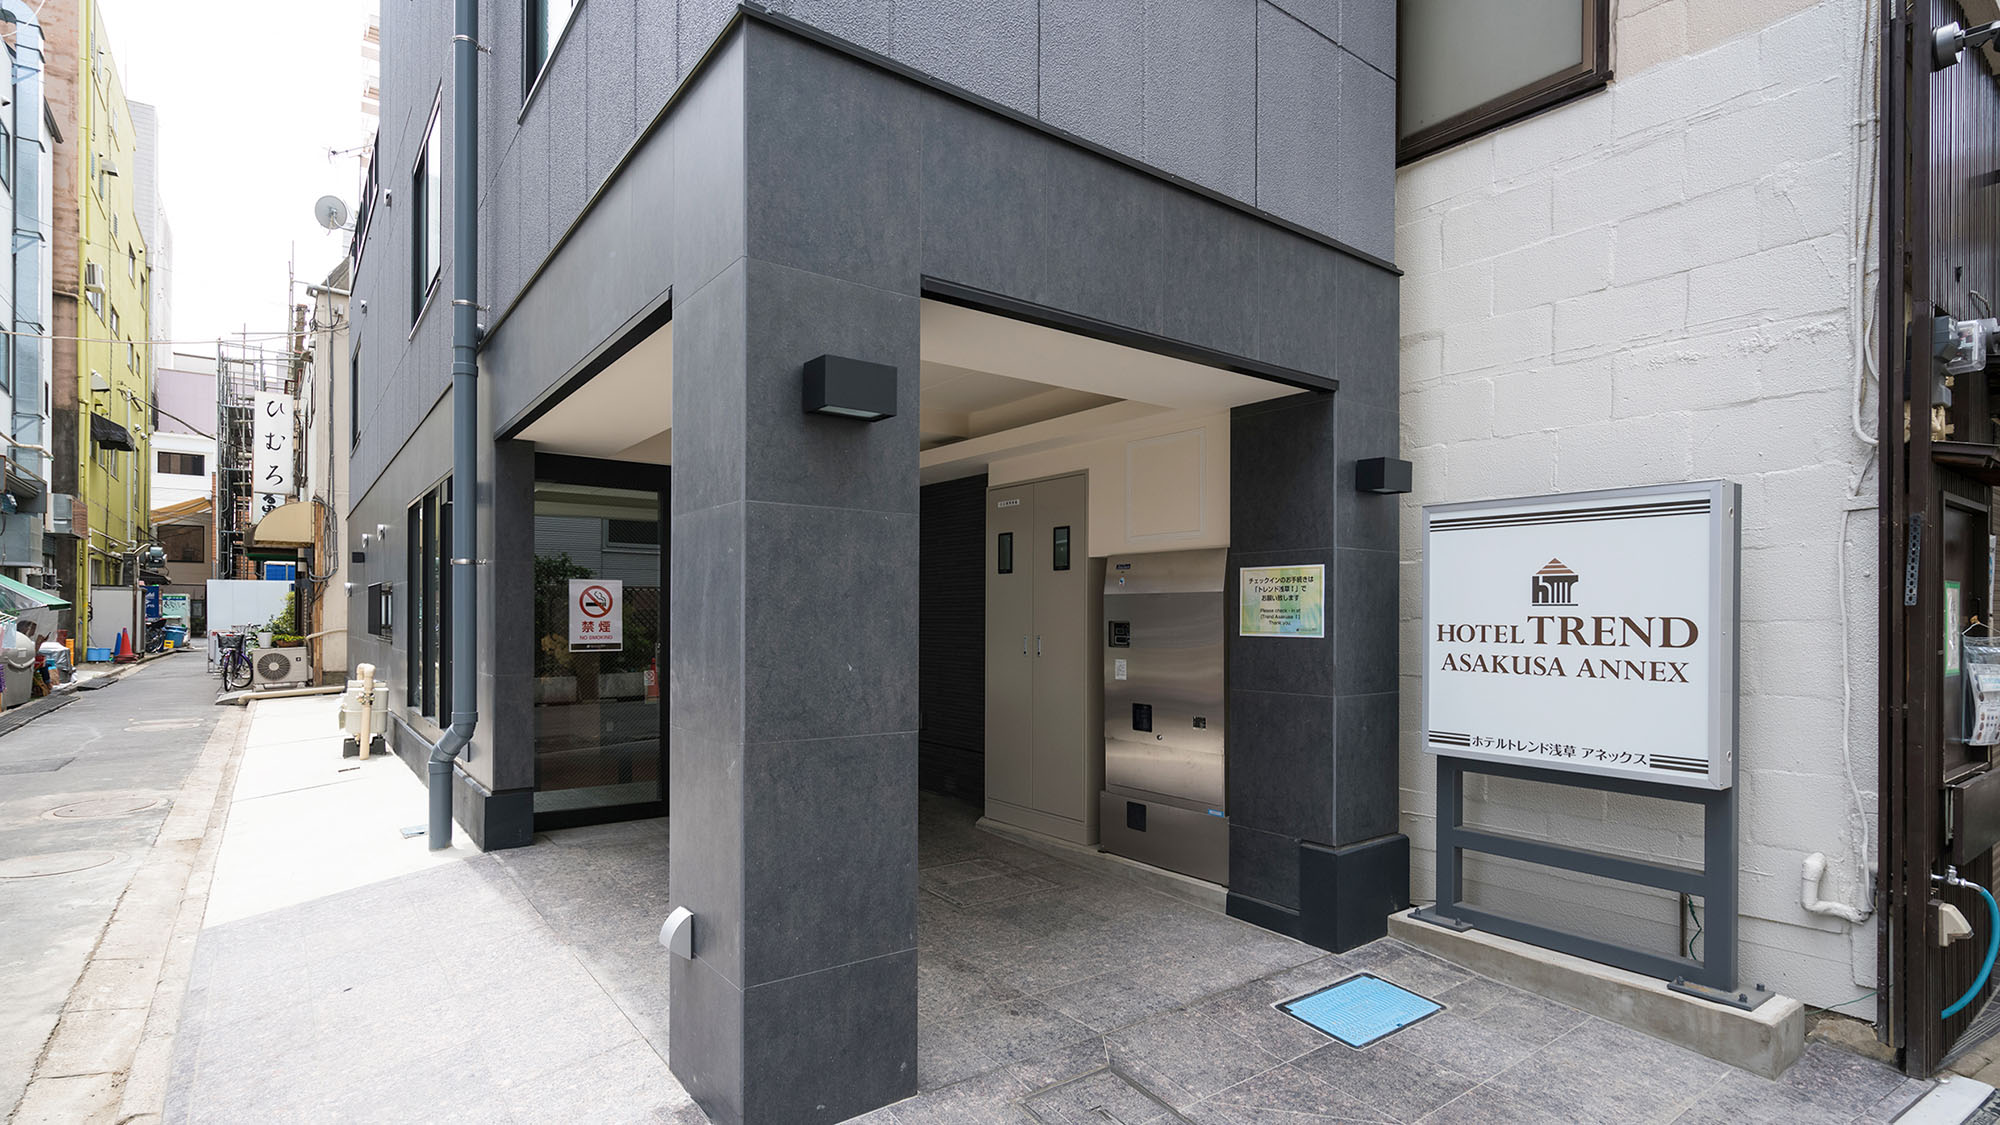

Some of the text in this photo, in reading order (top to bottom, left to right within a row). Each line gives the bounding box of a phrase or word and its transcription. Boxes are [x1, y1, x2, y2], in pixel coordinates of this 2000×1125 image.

[265, 400, 286, 486] ひむろ
[582, 620, 611, 632] 禁煙
[1437, 615, 1699, 648] HOTEL TREND
[1441, 652, 1690, 683] ASAKUSA ANNEX
[1472, 735, 1647, 766] ホテルトレンド浅草 アネックス
